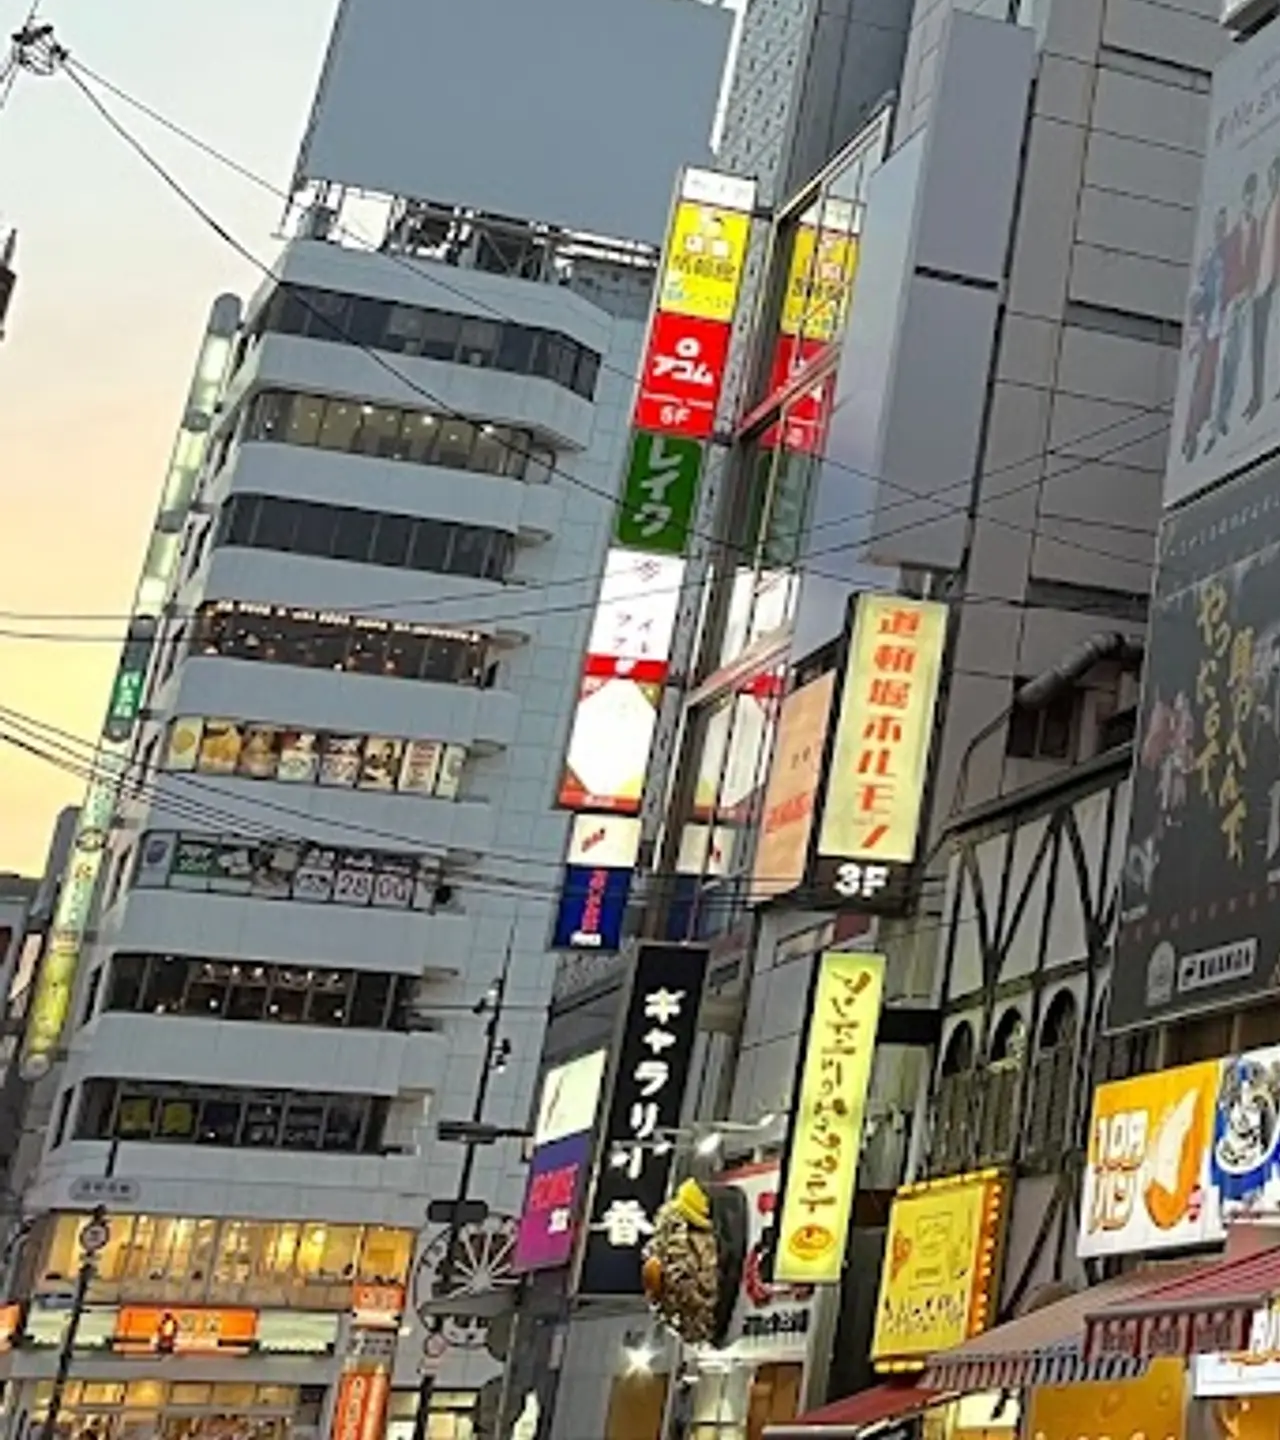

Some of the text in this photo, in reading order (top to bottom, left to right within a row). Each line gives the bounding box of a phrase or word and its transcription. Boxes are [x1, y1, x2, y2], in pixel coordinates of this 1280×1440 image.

[650, 354, 715, 387] アコム
[633, 435, 685, 539] レイク
[854, 609, 923, 850] 道頓堀ホルモン
[833, 863, 891, 898] 3F
